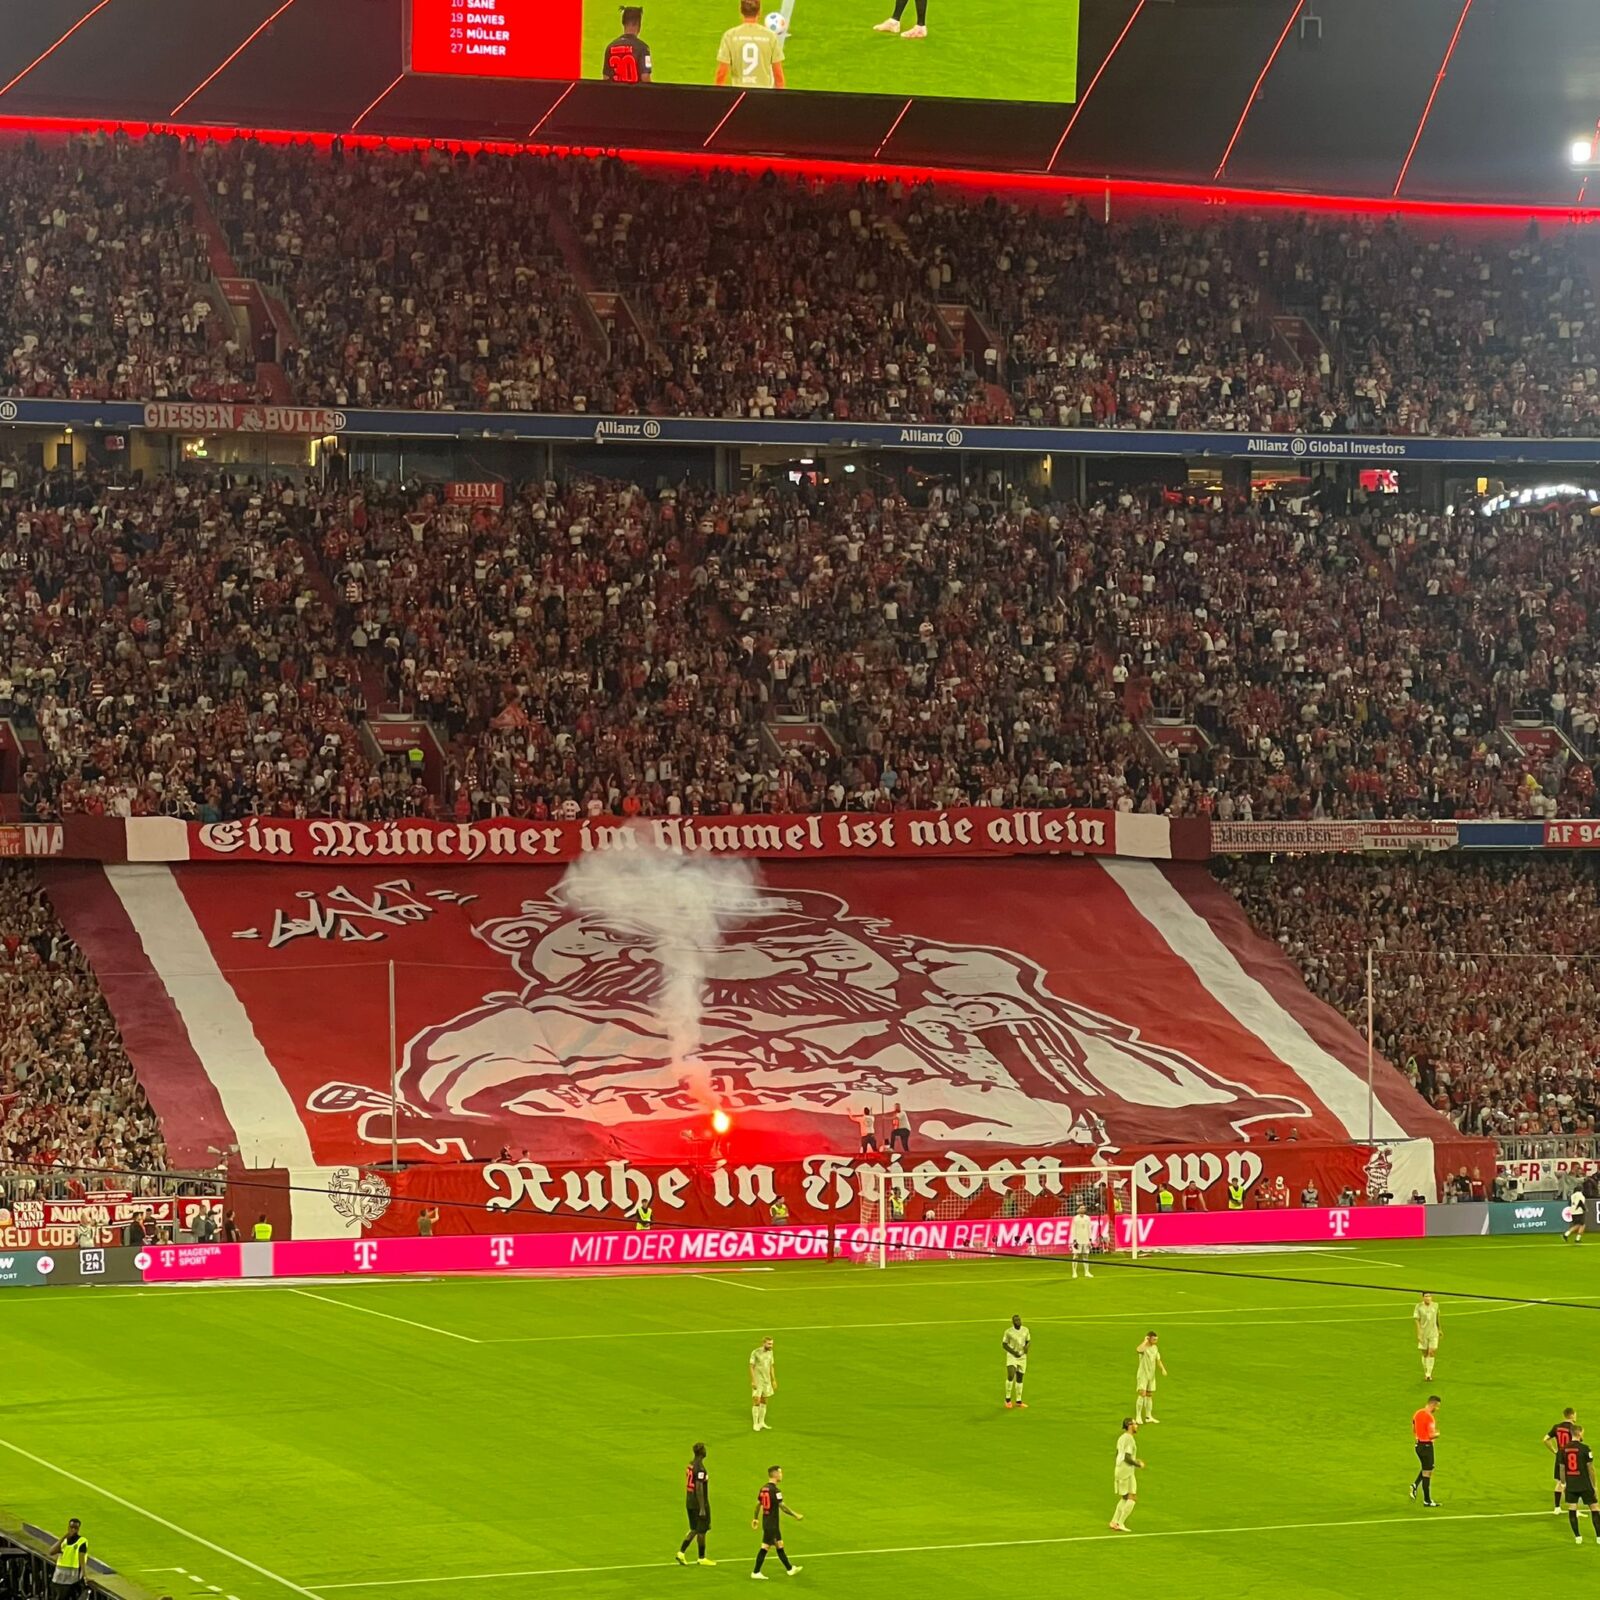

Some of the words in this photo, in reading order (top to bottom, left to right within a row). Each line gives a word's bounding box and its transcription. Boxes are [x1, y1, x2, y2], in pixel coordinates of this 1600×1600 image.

[451, 12, 464, 23] 19
[466, 13, 506, 26] DAVIES
[450, 27, 464, 38] 25
[466, 27, 510, 41] MÜLLER
[450, 43, 464, 54] 27
[466, 44, 507, 56] LAIMER
[742, 42, 759, 76] 9
[144, 403, 235, 429] GIESSEN
[263, 407, 337, 433] BULLS
[595, 421, 641, 435] Allianz
[900, 429, 944, 442] Allianz
[1247, 439, 1289, 452] Allianz
[1309, 441, 1348, 454] Global
[1350, 442, 1406, 455] Investors
[454, 482, 497, 498] RHM
[198, 818, 294, 855] Ein
[308, 821, 563, 861] Münchner
[579, 819, 639, 852] im
[650, 815, 824, 855] Himmel
[837, 814, 896, 848] ist
[908, 812, 974, 847] nie
[987, 811, 1106, 846] allein
[1547, 825, 1574, 843] AF
[482, 1159, 690, 1218] Ruhe
[711, 1158, 777, 1207] in
[802, 1151, 1064, 1211] Frieden
[13, 1201, 44, 1211] SEEN
[1514, 1206, 1545, 1219] WOW
[13, 1210, 45, 1221] LAND
[15, 1220, 45, 1228] FRONT
[570, 1236, 619, 1262] MIT
[622, 1234, 675, 1261] DER
[679, 1232, 755, 1259] MEGA
[760, 1228, 848, 1257] SPORT
[850, 1225, 948, 1253] OPTION
[952, 1224, 993, 1250] BEI
[1121, 1218, 1155, 1243] TV
[178, 1247, 222, 1256] MAGENTA
[178, 1256, 208, 1266] SPORT
[1567, 1453, 1578, 1472] 8
